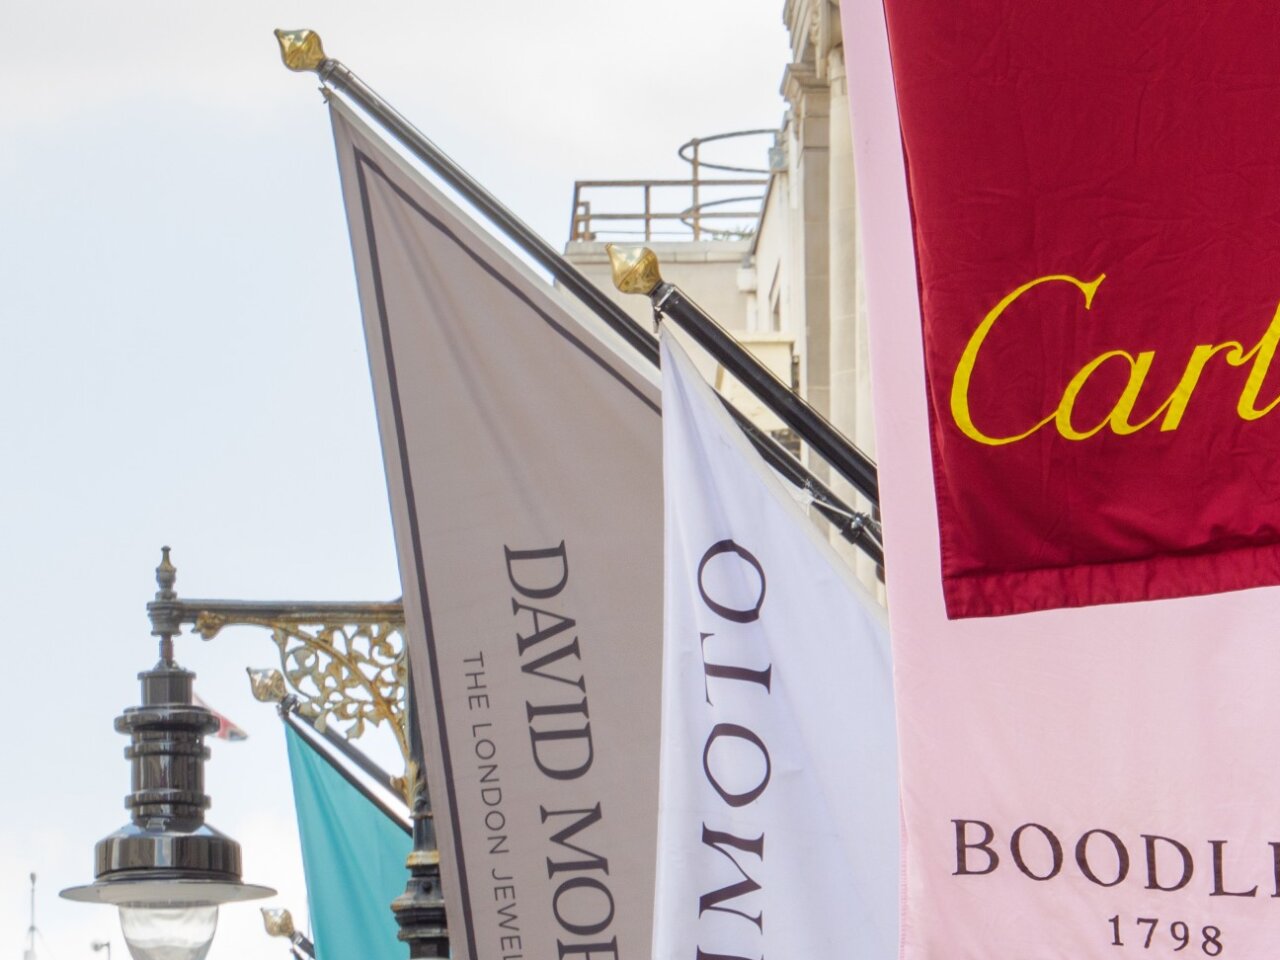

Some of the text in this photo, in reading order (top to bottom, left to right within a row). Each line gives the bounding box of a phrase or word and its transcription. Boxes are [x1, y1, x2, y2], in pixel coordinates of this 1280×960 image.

[463, 651, 490, 710] THE
[504, 539, 594, 781] DAVID
[472, 723, 510, 855] LONDON
[1108, 914, 1224, 957] 1798
